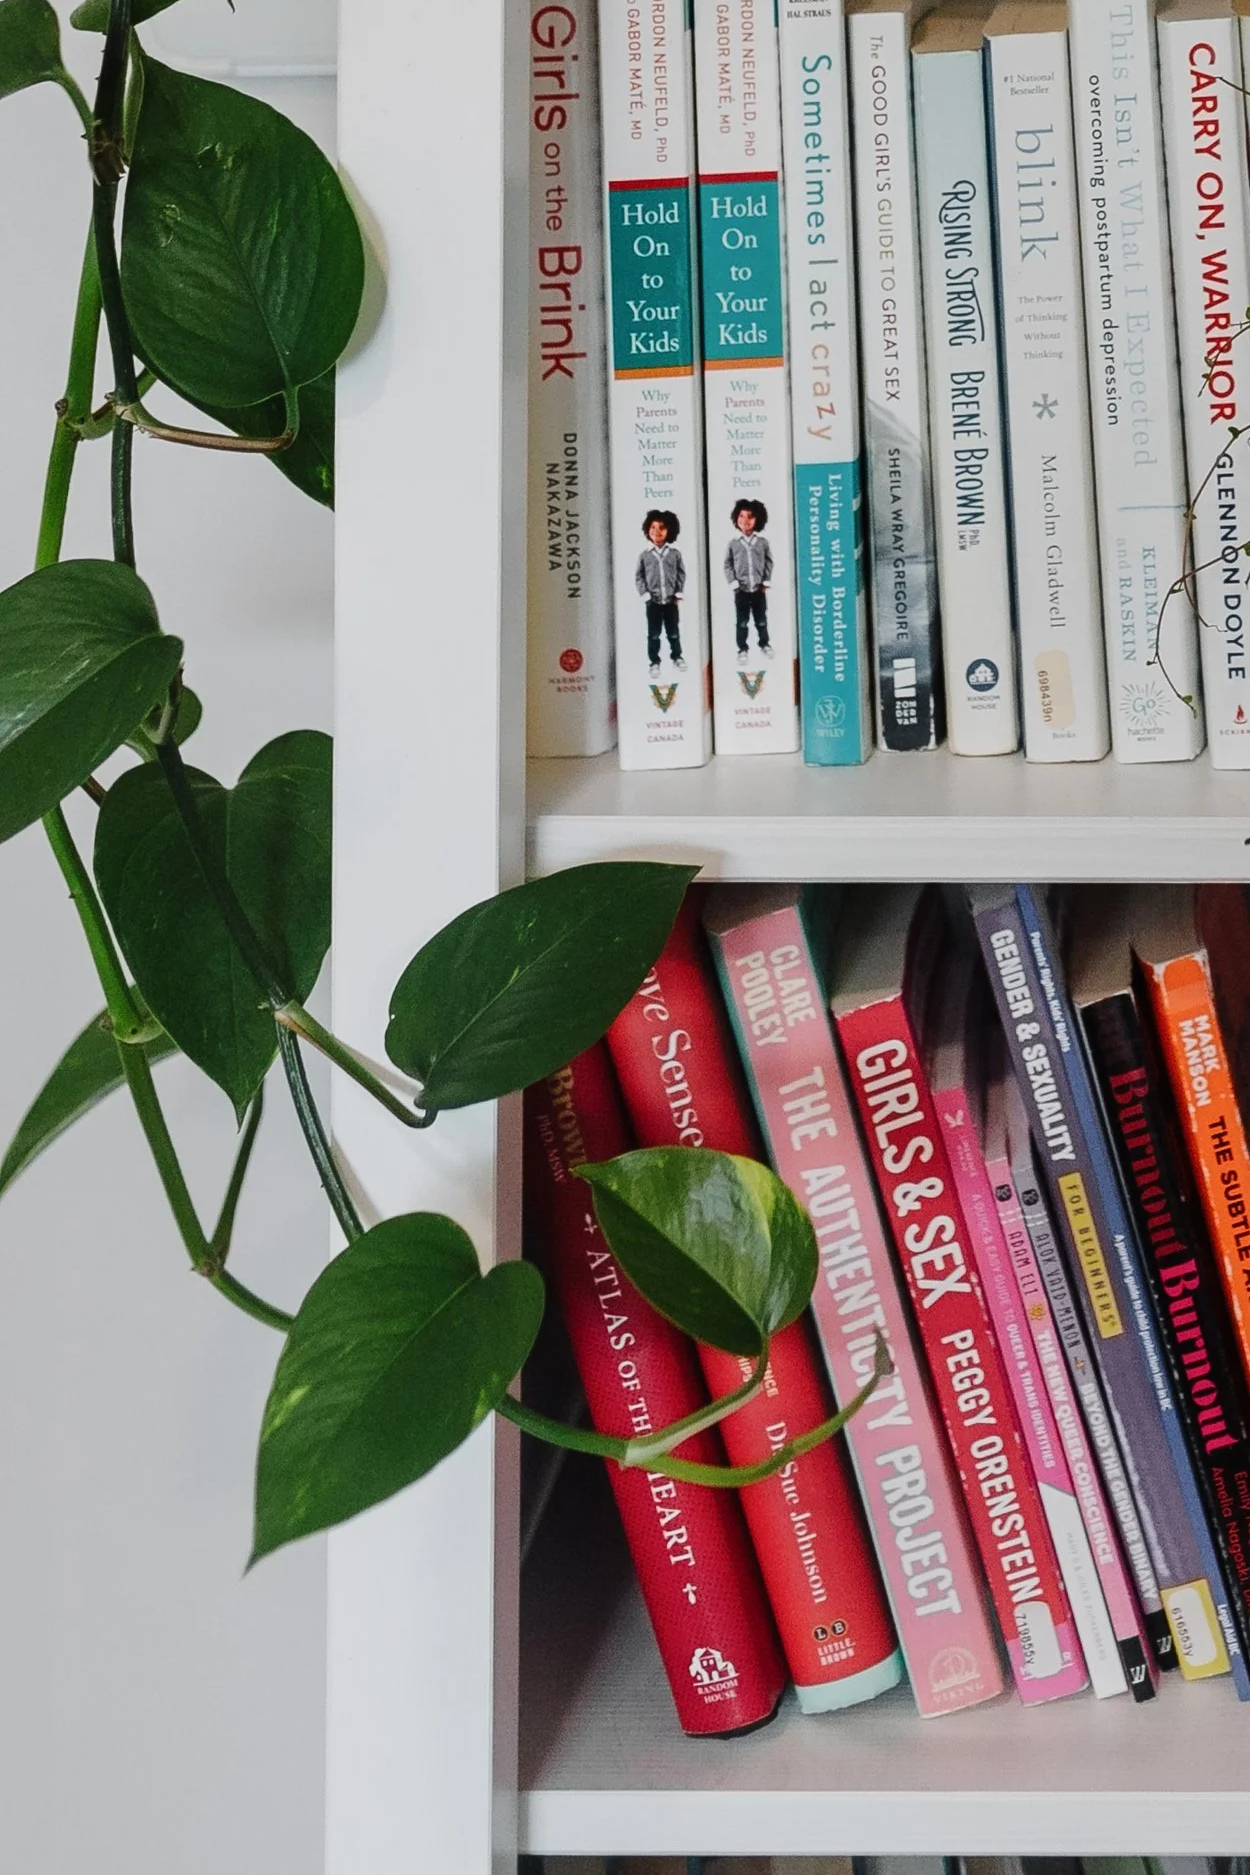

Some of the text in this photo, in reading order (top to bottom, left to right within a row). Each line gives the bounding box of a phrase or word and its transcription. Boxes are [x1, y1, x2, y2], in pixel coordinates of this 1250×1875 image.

[530, 5, 587, 381] Girls on the Brink
[622, 202, 680, 226] Hold
[710, 196, 768, 219] Hold
[801, 54, 832, 245] Sometimes
[870, 35, 900, 401] The GOOD GIRL'S GUIDE TO GREAT SEX
[1015, 124, 1059, 263] blink
[633, 235, 670, 257] On
[641, 272, 664, 290] to
[715, 292, 768, 315] Your
[722, 227, 758, 251] On
[730, 265, 752, 282] to
[809, 279, 836, 331] act
[938, 179, 985, 347] RISING STRONG
[1089, 75, 1122, 426] overcoming postpartum depression
[1188, 42, 1236, 425] CARRY ON, WARRIOR
[627, 300, 680, 324] Your
[630, 331, 680, 355] Kids
[718, 322, 768, 346] Kids
[806, 343, 837, 441] crazy
[951, 370, 989, 526] BRENÉ BROWN
[545, 462, 563, 572] NAKAZAWA
[563, 432, 582, 600] DONNA JACKSON
[808, 485, 828, 673] Personality Disorder
[826, 474, 848, 682] Living with Borderline
[888, 448, 909, 642] SHEILA WRAY GREGOIRE
[1041, 454, 1066, 628] Malcolm Gladwell
[1217, 452, 1246, 680] GLENNON DOYLE
[735, 950, 787, 1047] POOLEY
[770, 944, 817, 1027] CLARE
[989, 928, 1076, 1162] GENDER & SEXUALITY
[1194, 1014, 1221, 1073] MARK
[1179, 1020, 1212, 1107] MANSON
[856, 1039, 972, 1310] GIRLS & SEX
[1110, 1068, 1188, 1261] Burnout
[1208, 1115, 1234, 1165] THE
[1159, 1258, 1239, 1455] Burnout
[875, 1444, 961, 1617] PROJECT
[940, 1328, 1044, 1603] PEGGY ORENSTEIN
